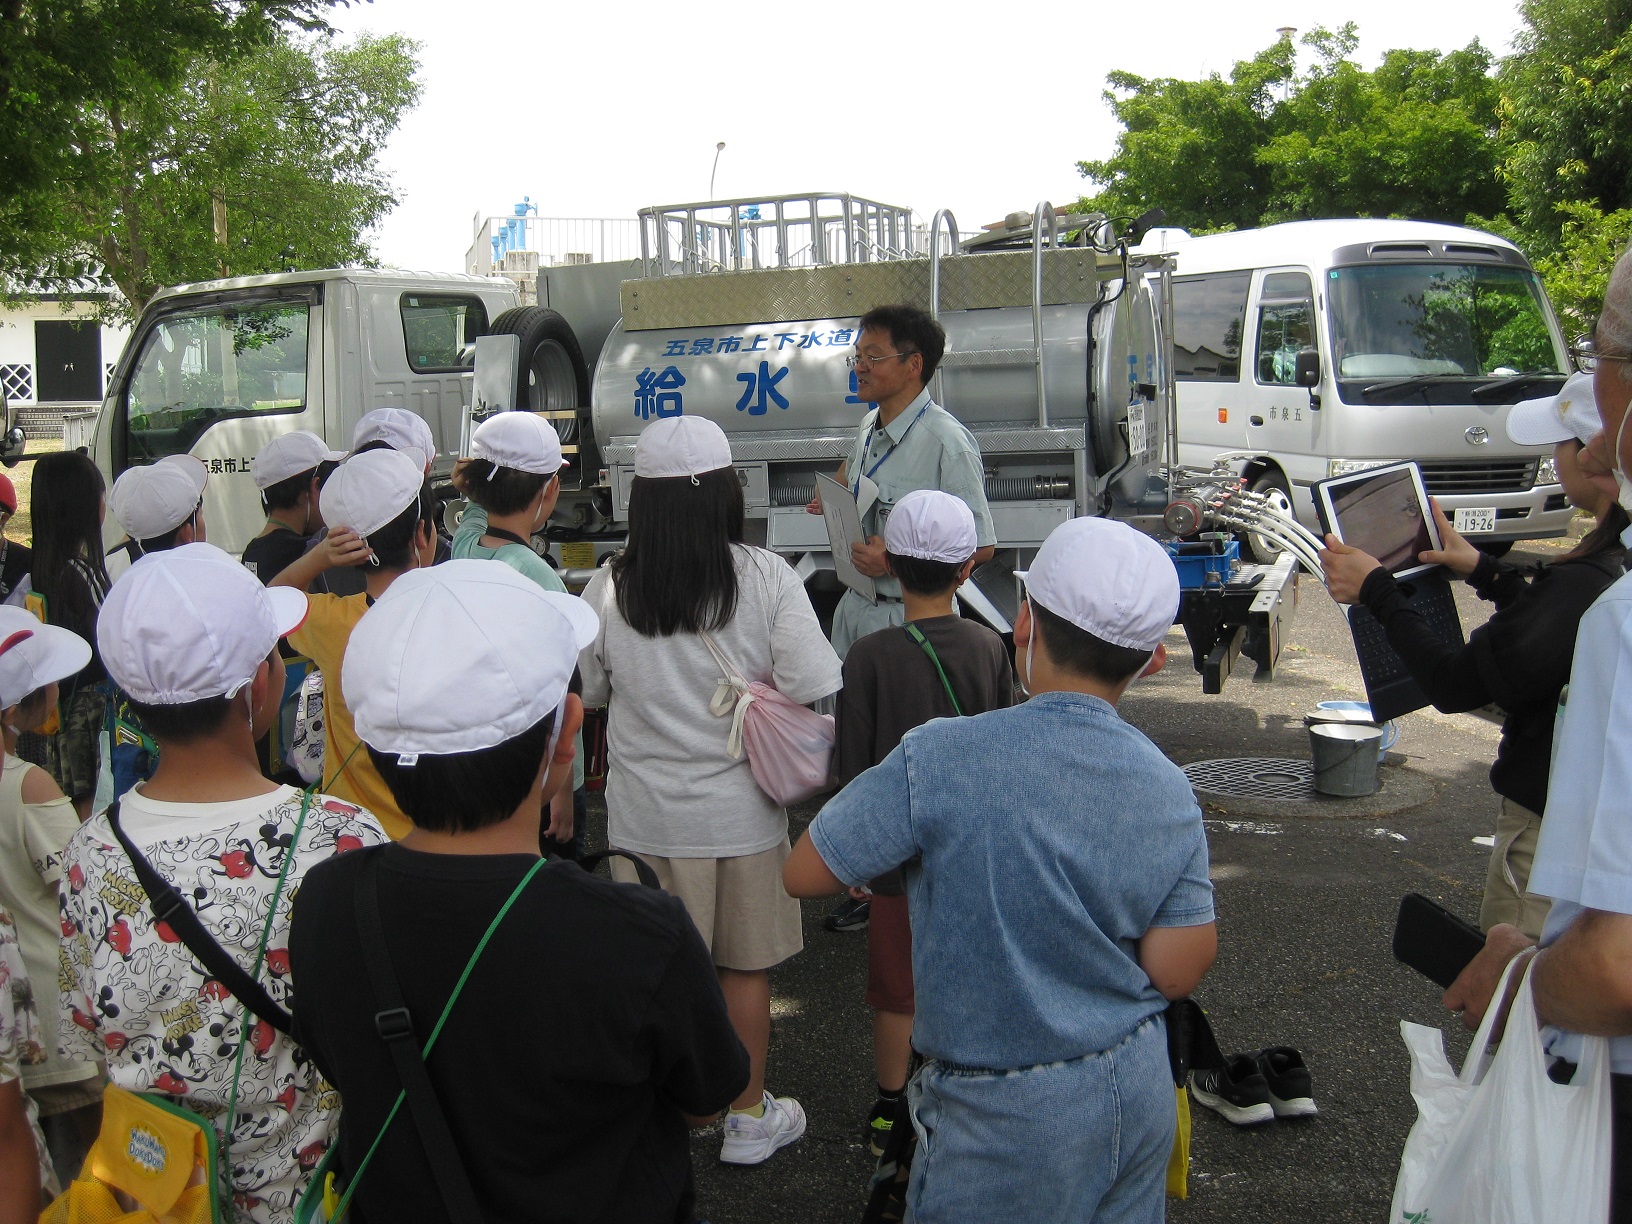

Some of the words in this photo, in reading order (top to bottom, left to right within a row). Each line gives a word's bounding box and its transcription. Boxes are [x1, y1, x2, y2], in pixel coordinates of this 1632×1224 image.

[661, 328, 865, 357] 五泉市上下水道
[201, 456, 256, 474] 泉市上
[1464, 518, 1493, 531] 19-26
[99, 884, 141, 918] MOUSE
